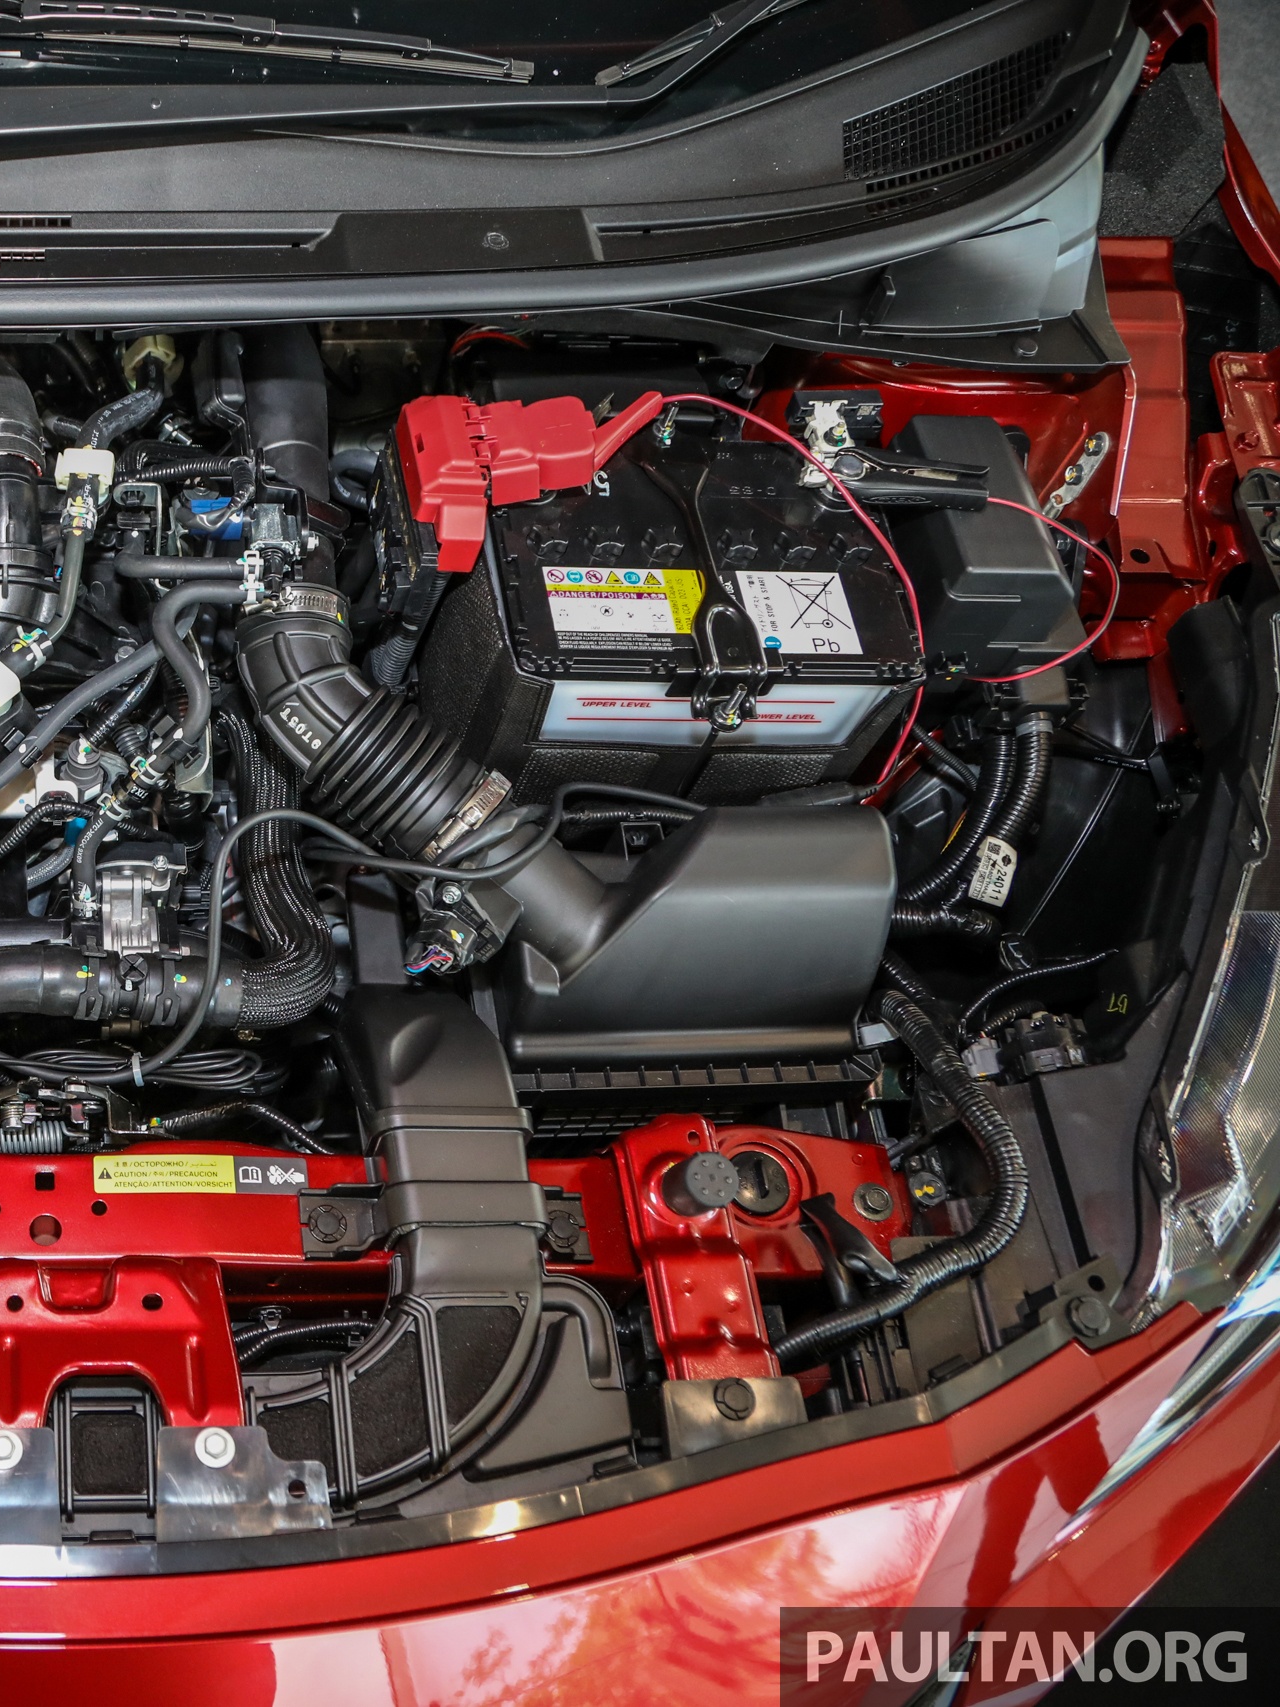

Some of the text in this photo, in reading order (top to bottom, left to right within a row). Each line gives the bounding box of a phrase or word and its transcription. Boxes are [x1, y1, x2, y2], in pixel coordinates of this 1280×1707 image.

[558, 591, 638, 600] DANGER/POISON
[812, 637, 841, 653] Pb
[989, 869, 1008, 901] 24011
